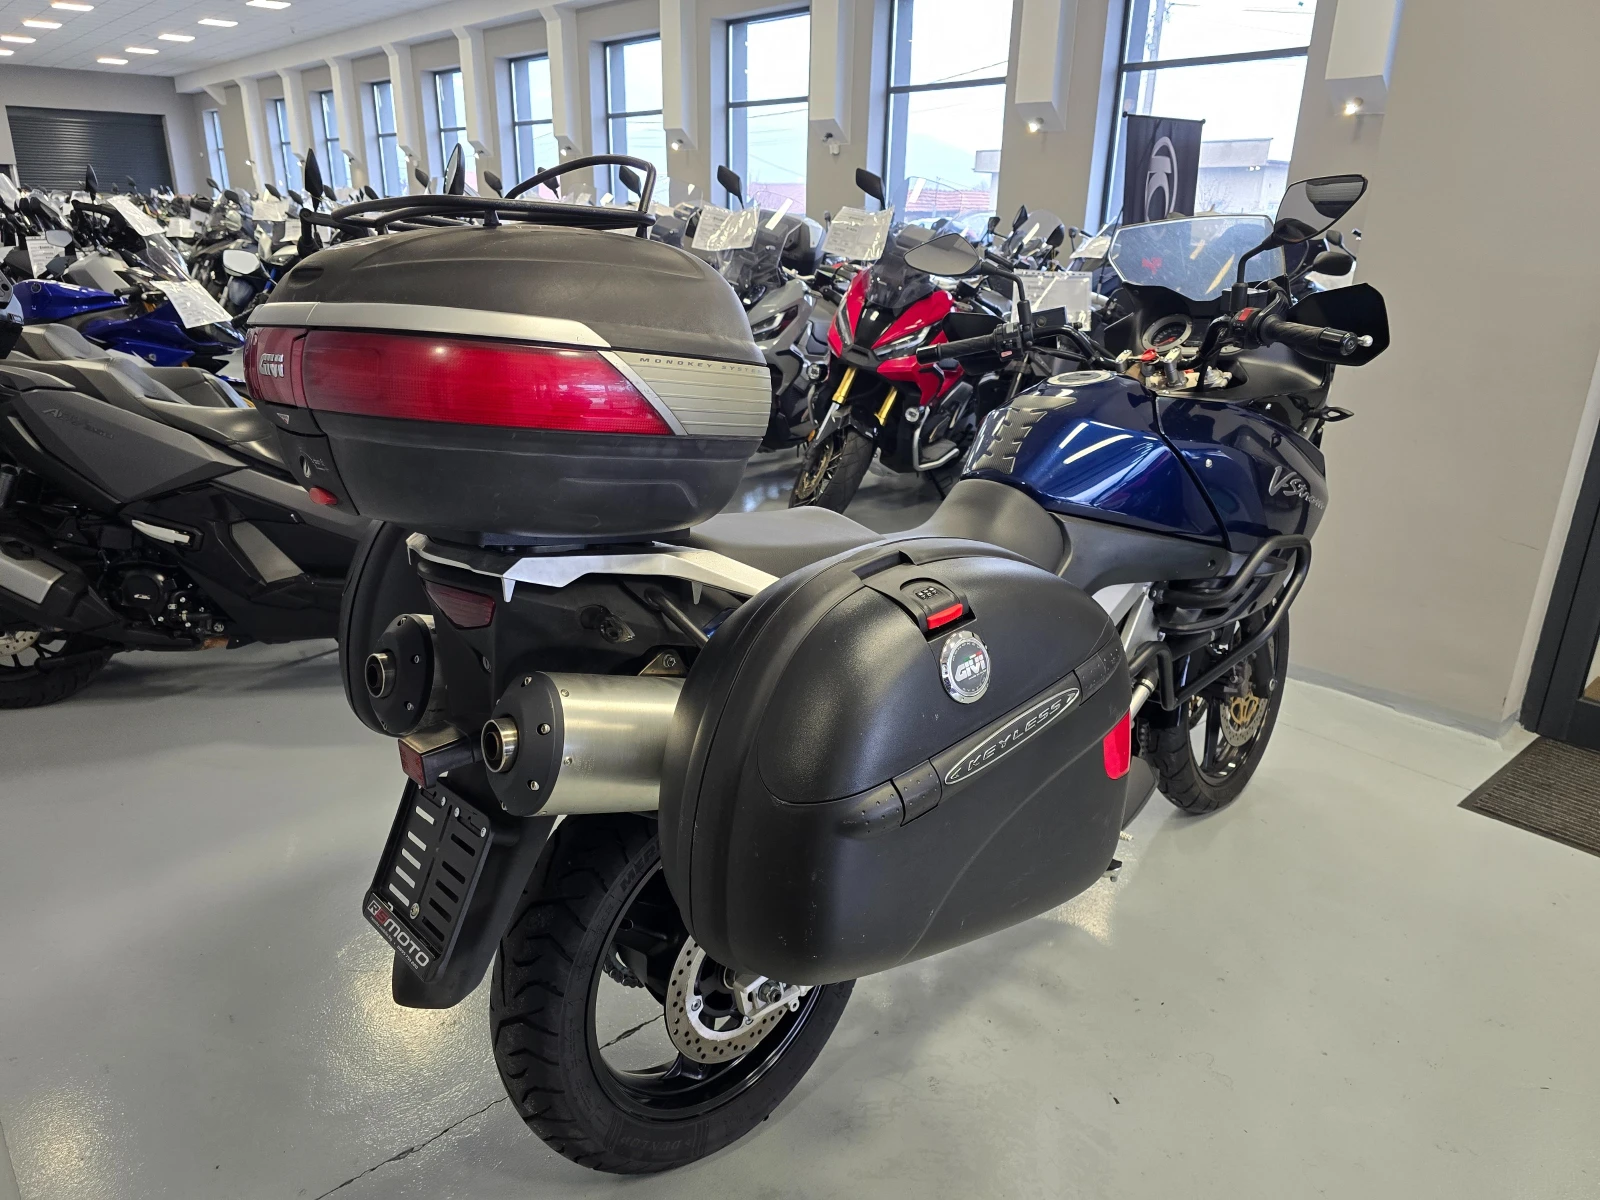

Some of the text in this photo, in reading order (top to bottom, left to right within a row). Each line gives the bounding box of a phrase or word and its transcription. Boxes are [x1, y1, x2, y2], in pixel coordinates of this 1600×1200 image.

[259, 353, 285, 378] GIVI
[640, 357, 712, 368] MONOKEY
[955, 655, 987, 682] GIVI
[968, 699, 1061, 771] KEYLESS
